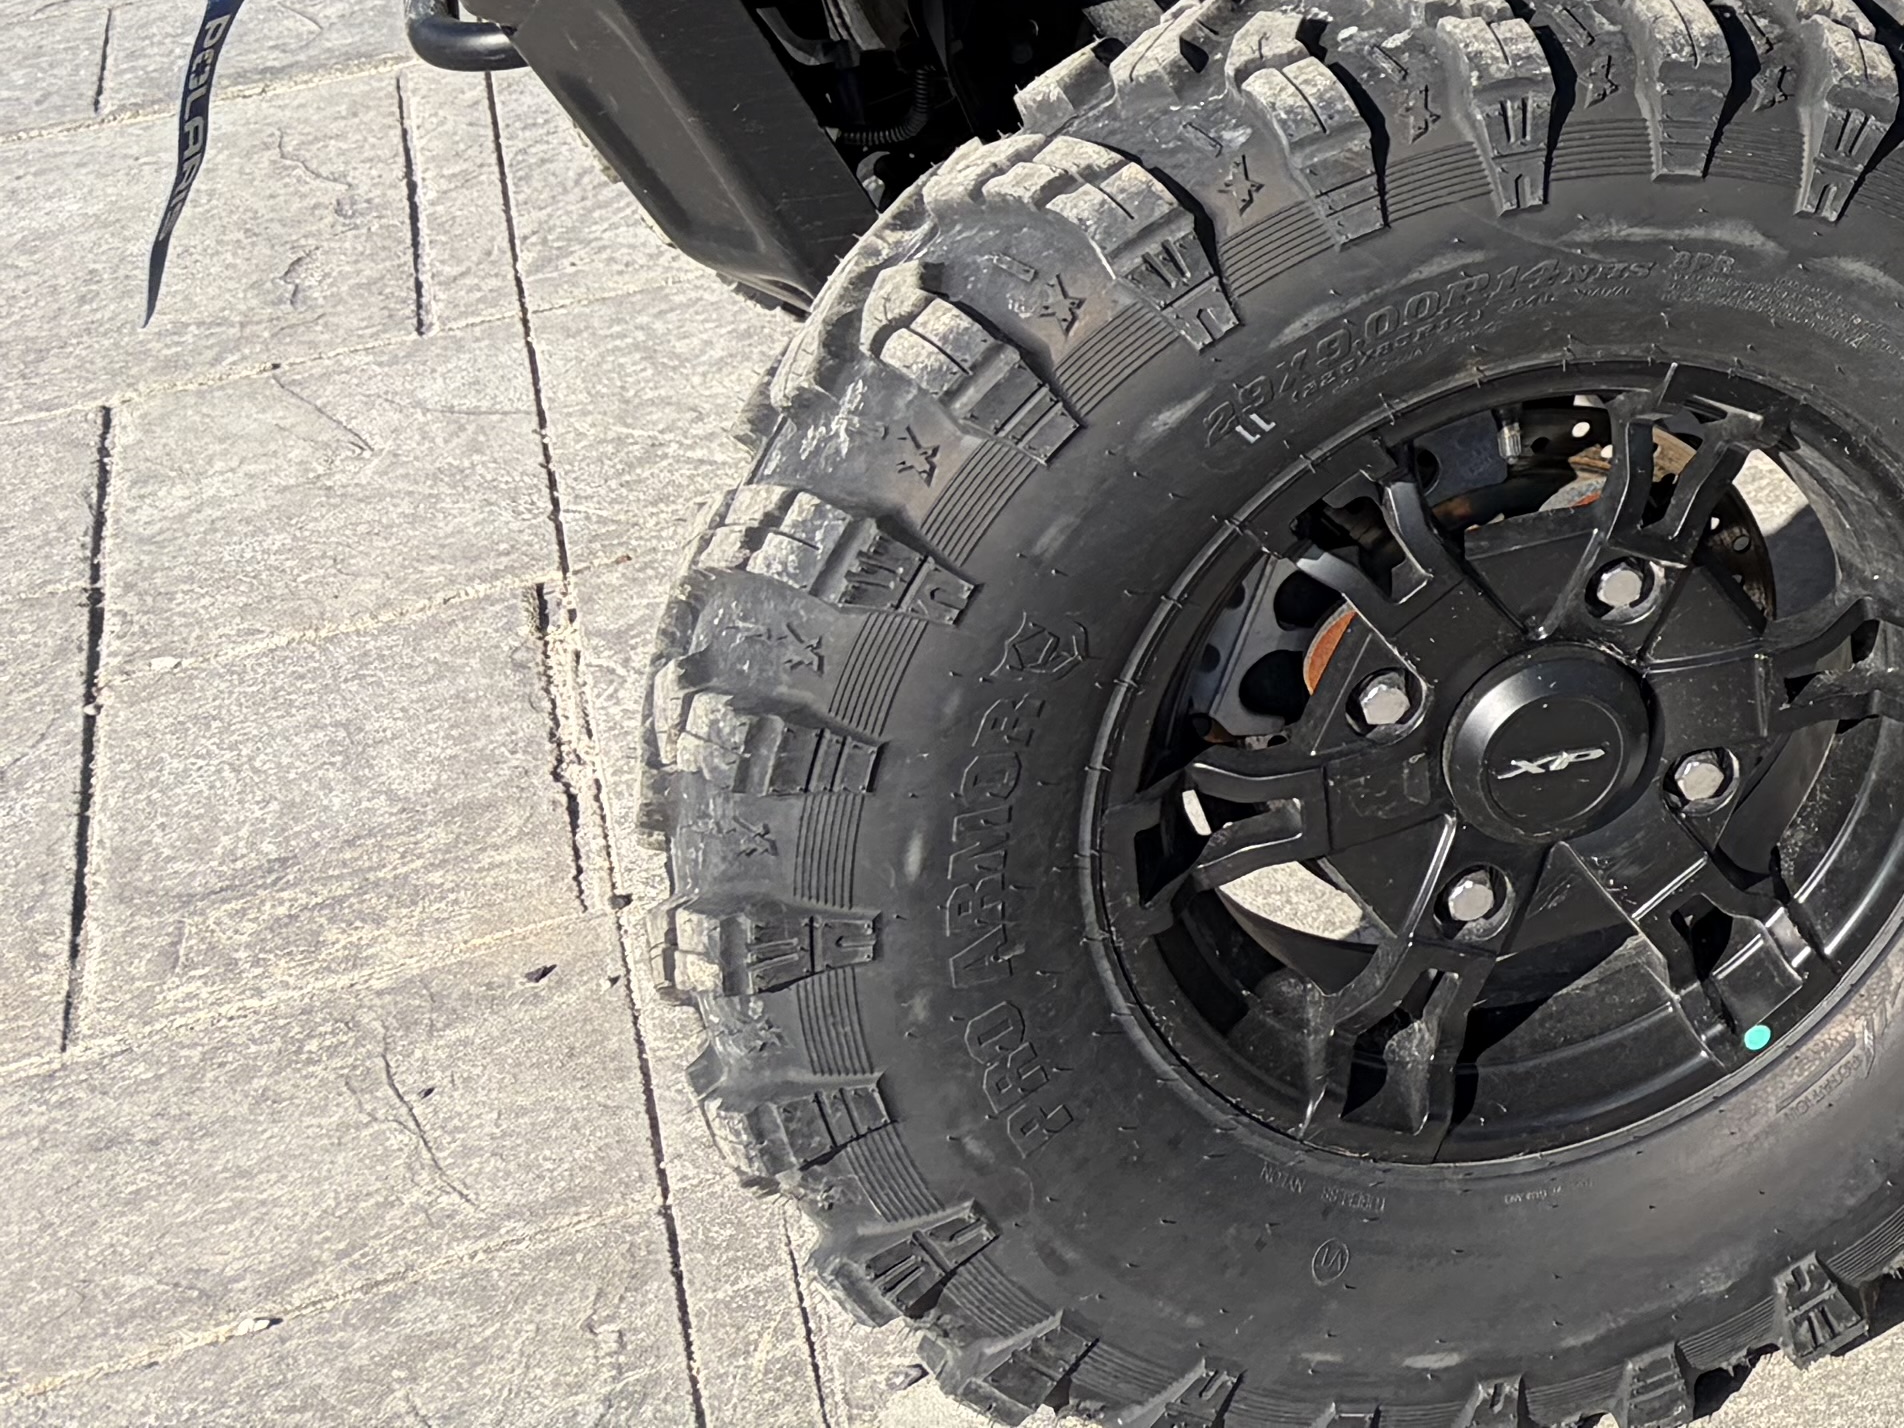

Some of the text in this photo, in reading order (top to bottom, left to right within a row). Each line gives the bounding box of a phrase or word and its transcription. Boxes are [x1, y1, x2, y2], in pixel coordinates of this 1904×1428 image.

[158, 13, 231, 241] POLARIS
[946, 693, 1047, 988] ARMOR
[1497, 749, 1606, 779] XP
